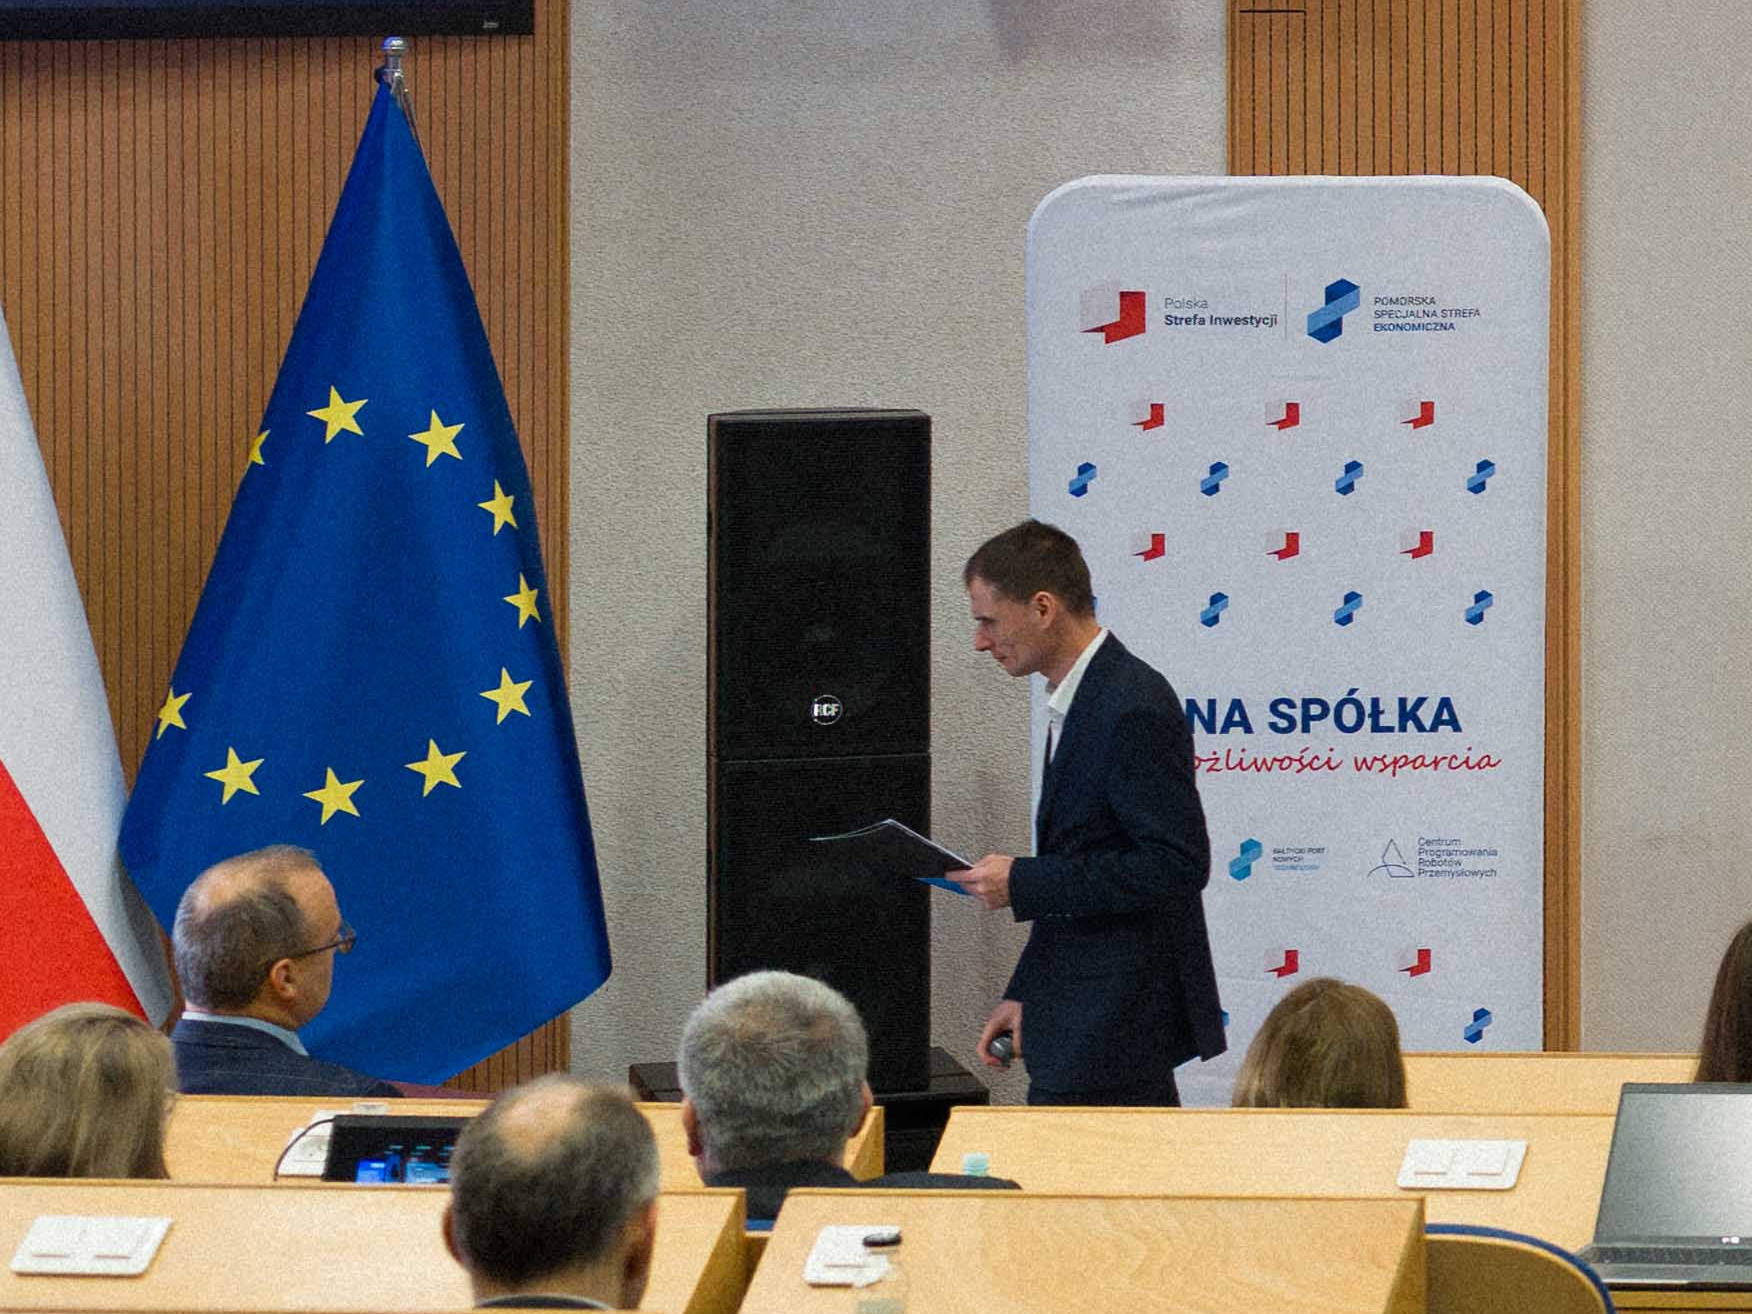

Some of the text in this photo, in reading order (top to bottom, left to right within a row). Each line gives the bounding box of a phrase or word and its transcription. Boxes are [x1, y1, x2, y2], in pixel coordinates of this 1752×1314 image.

[1164, 298, 1209, 310] Polska
[1373, 296, 1437, 307] POMORSKA
[1373, 308, 1481, 319] SPECJALNA STREFA
[1164, 314, 1278, 328] Strefa Inwestycji
[1373, 322, 1456, 332] EKONOMICZNA
[813, 703, 840, 717] RCF
[1268, 688, 1463, 735] SPÓŁKA
[1353, 745, 1504, 778] wsparcia
[1417, 837, 1461, 847] Centrum
